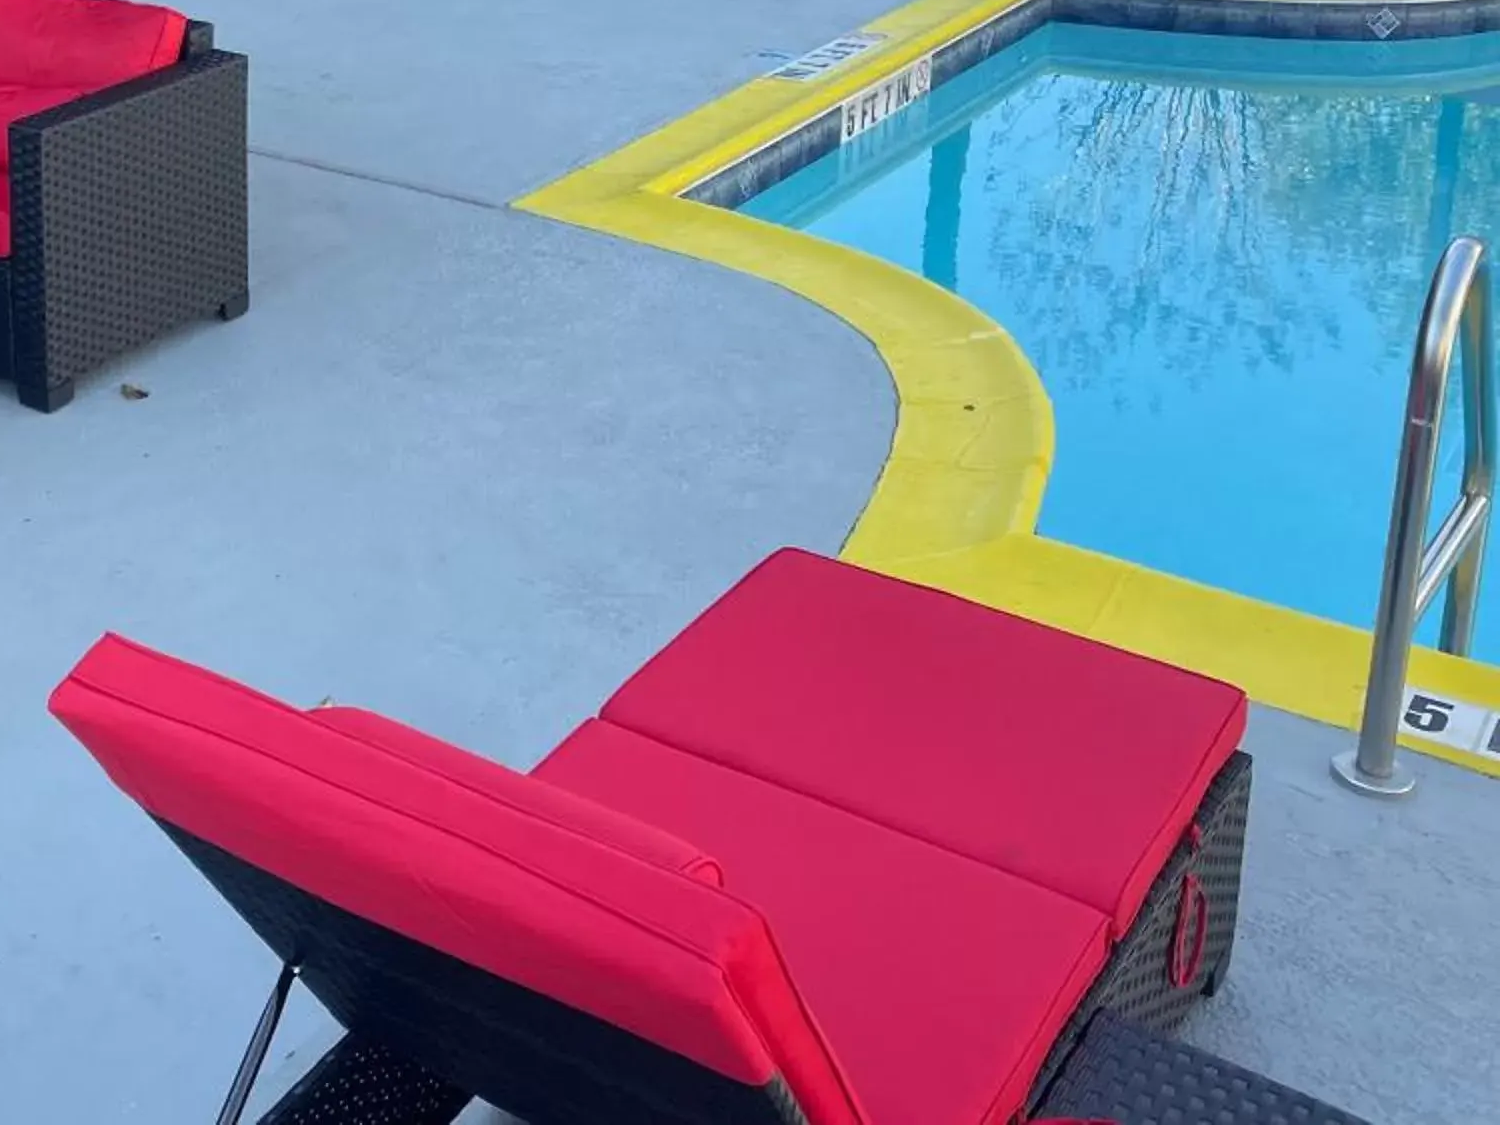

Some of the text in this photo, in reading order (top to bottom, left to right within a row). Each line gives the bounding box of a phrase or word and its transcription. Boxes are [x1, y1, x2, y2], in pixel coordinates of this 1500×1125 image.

[846, 105, 855, 136] 5
[862, 92, 877, 129] FT
[1404, 694, 1455, 732] 5
